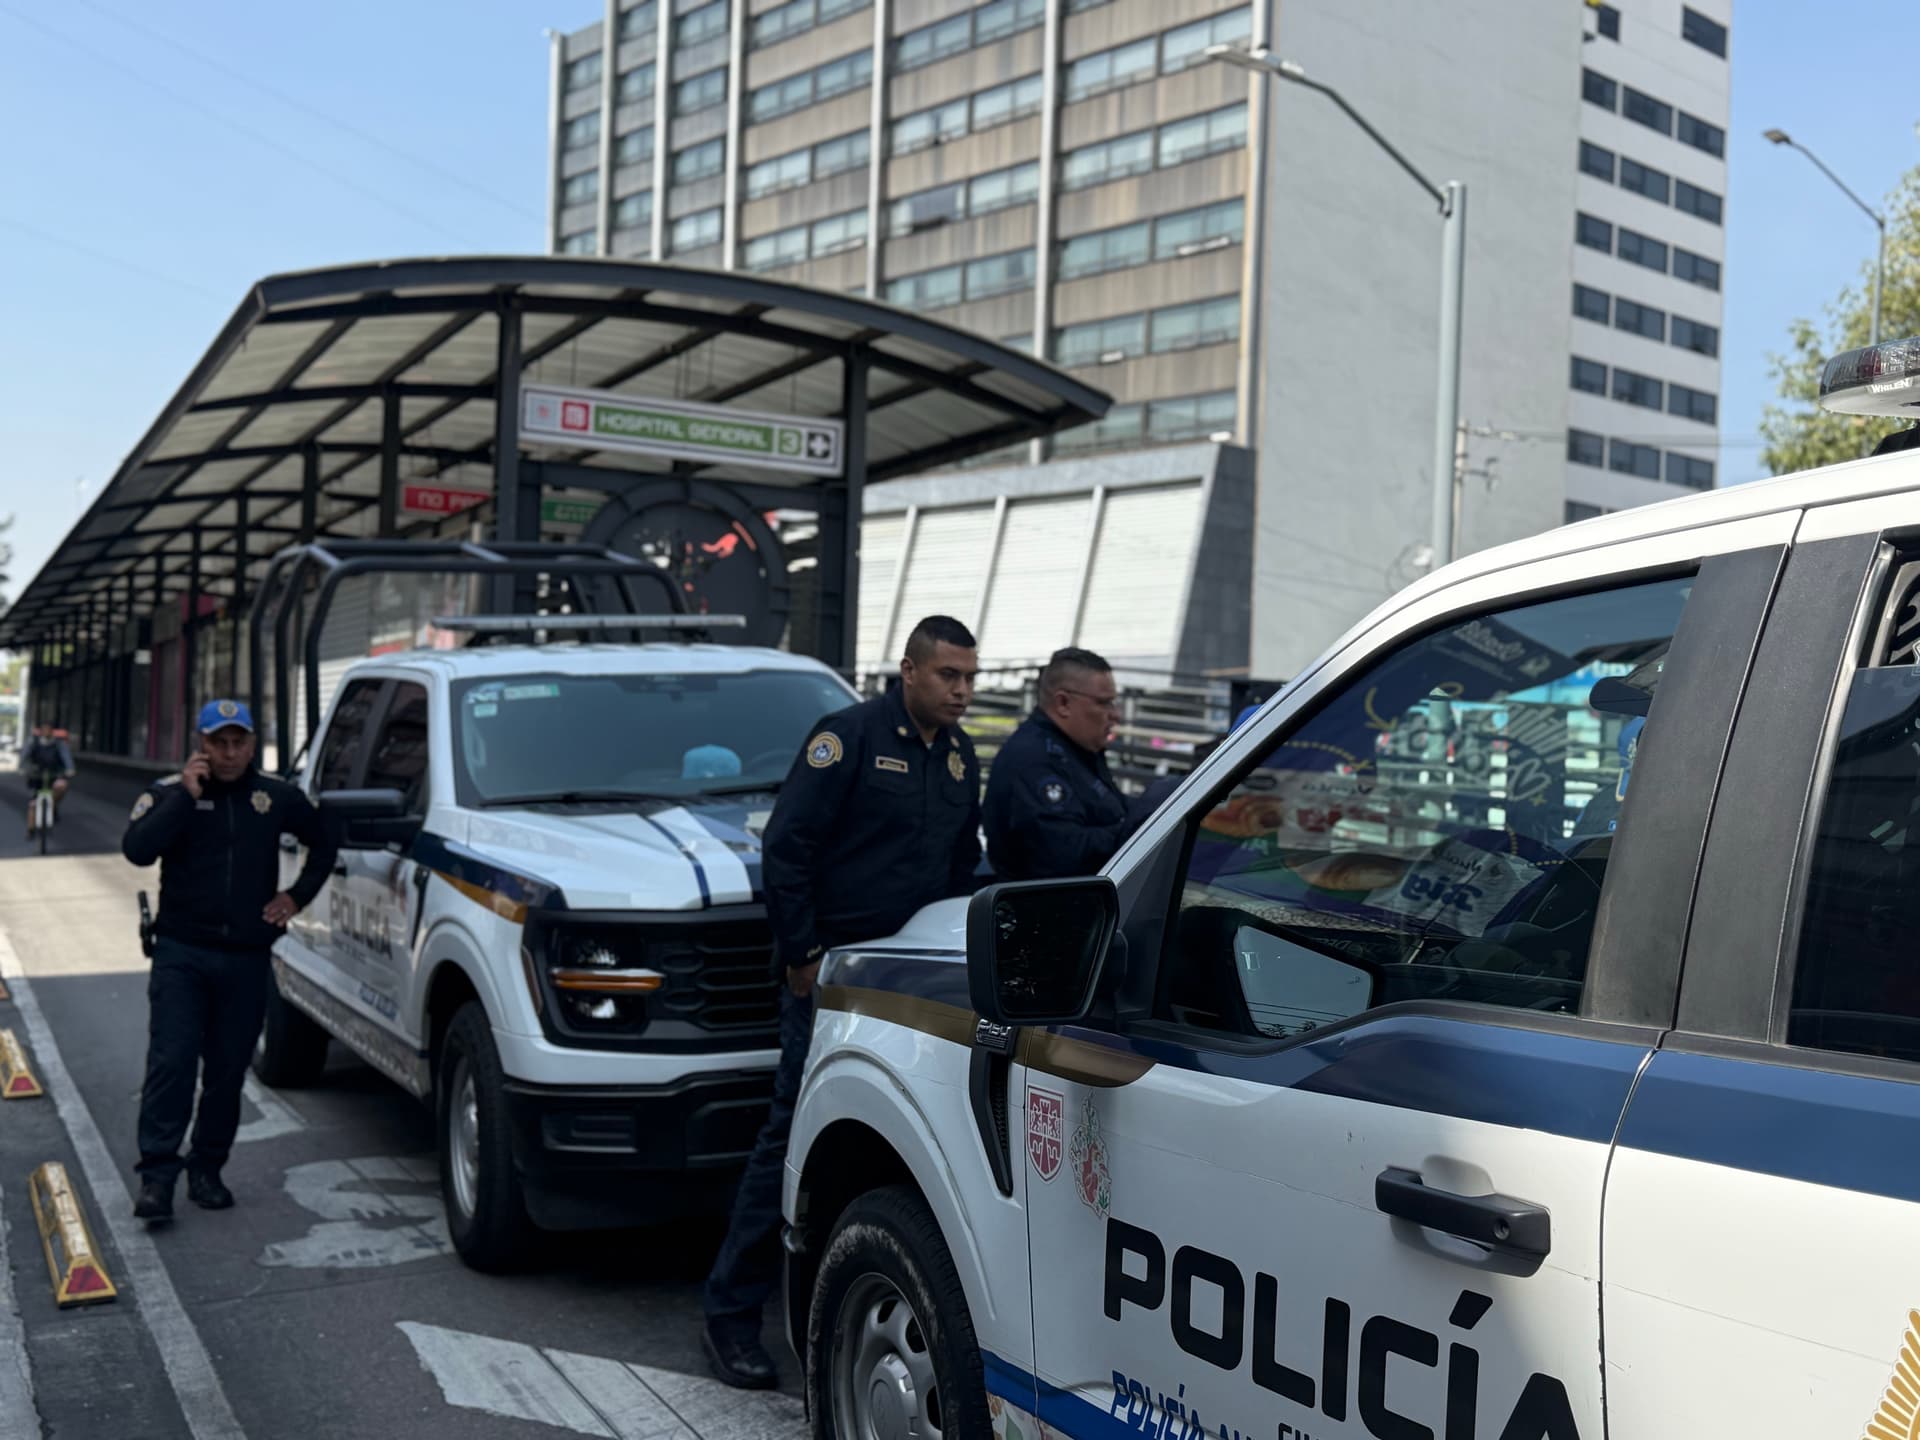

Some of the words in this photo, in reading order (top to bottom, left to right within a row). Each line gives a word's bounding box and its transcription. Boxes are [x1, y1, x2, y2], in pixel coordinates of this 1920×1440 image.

[599, 411, 684, 439] HOSPITAL
[688, 422, 768, 448] GENERAL
[781, 431, 799, 454] 3
[1105, 1218, 1581, 1440] POLICÍA
